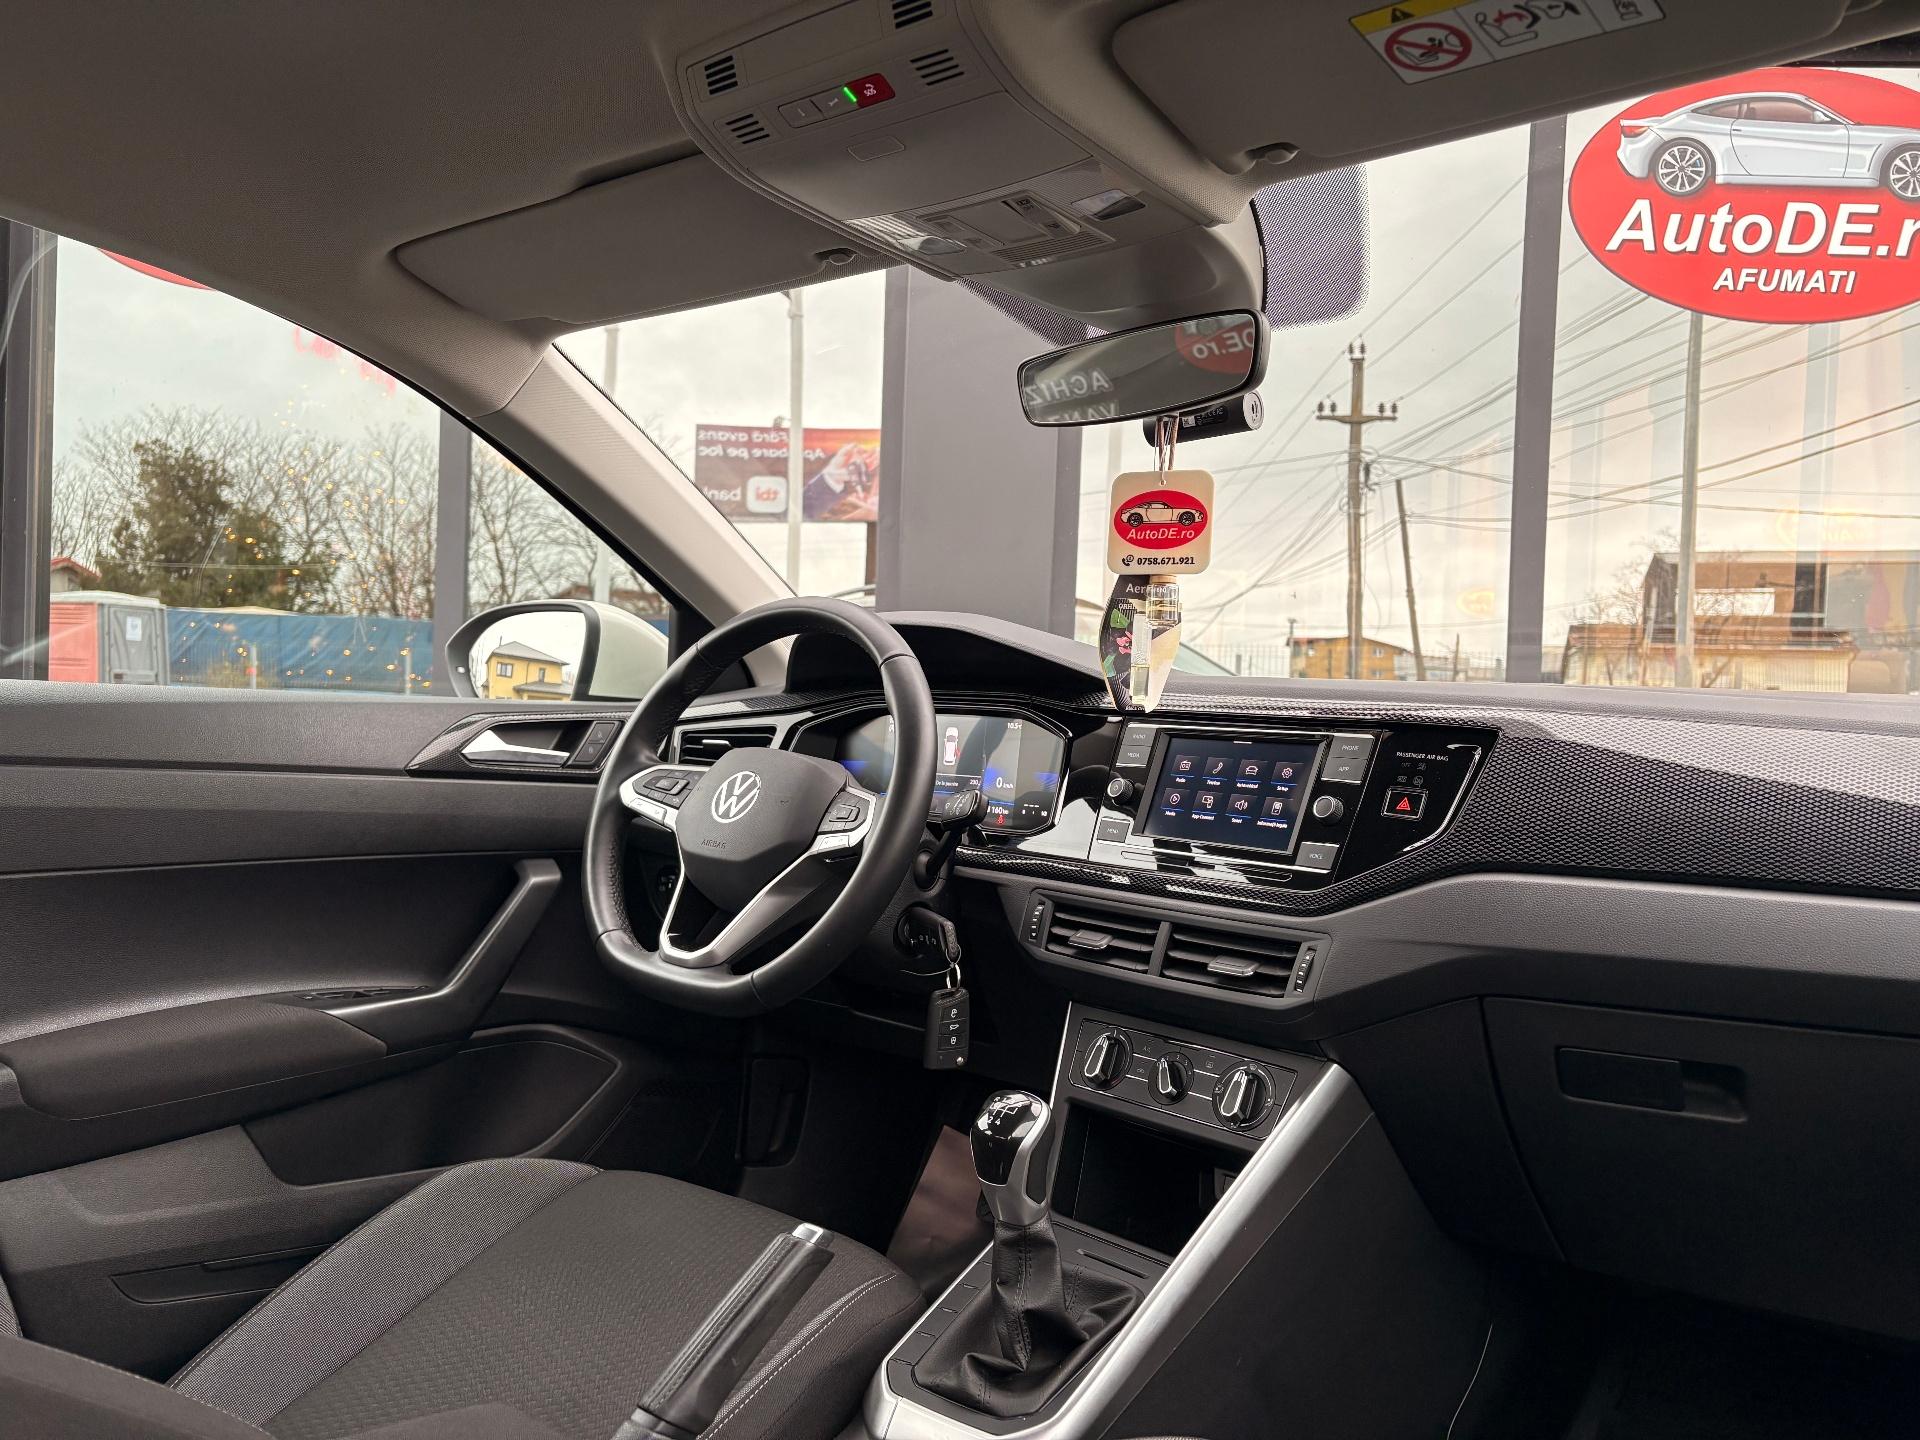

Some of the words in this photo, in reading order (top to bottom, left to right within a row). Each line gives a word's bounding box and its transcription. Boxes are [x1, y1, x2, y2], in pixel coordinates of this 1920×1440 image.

[1712, 267, 1857, 294] AFUMATI
[1126, 527, 1195, 540] AutoDE.ro
[1136, 556, 1196, 566] 0758.671.921
[1396, 751, 1425, 760] PASSENGER
[1436, 754, 1449, 762] BAG
